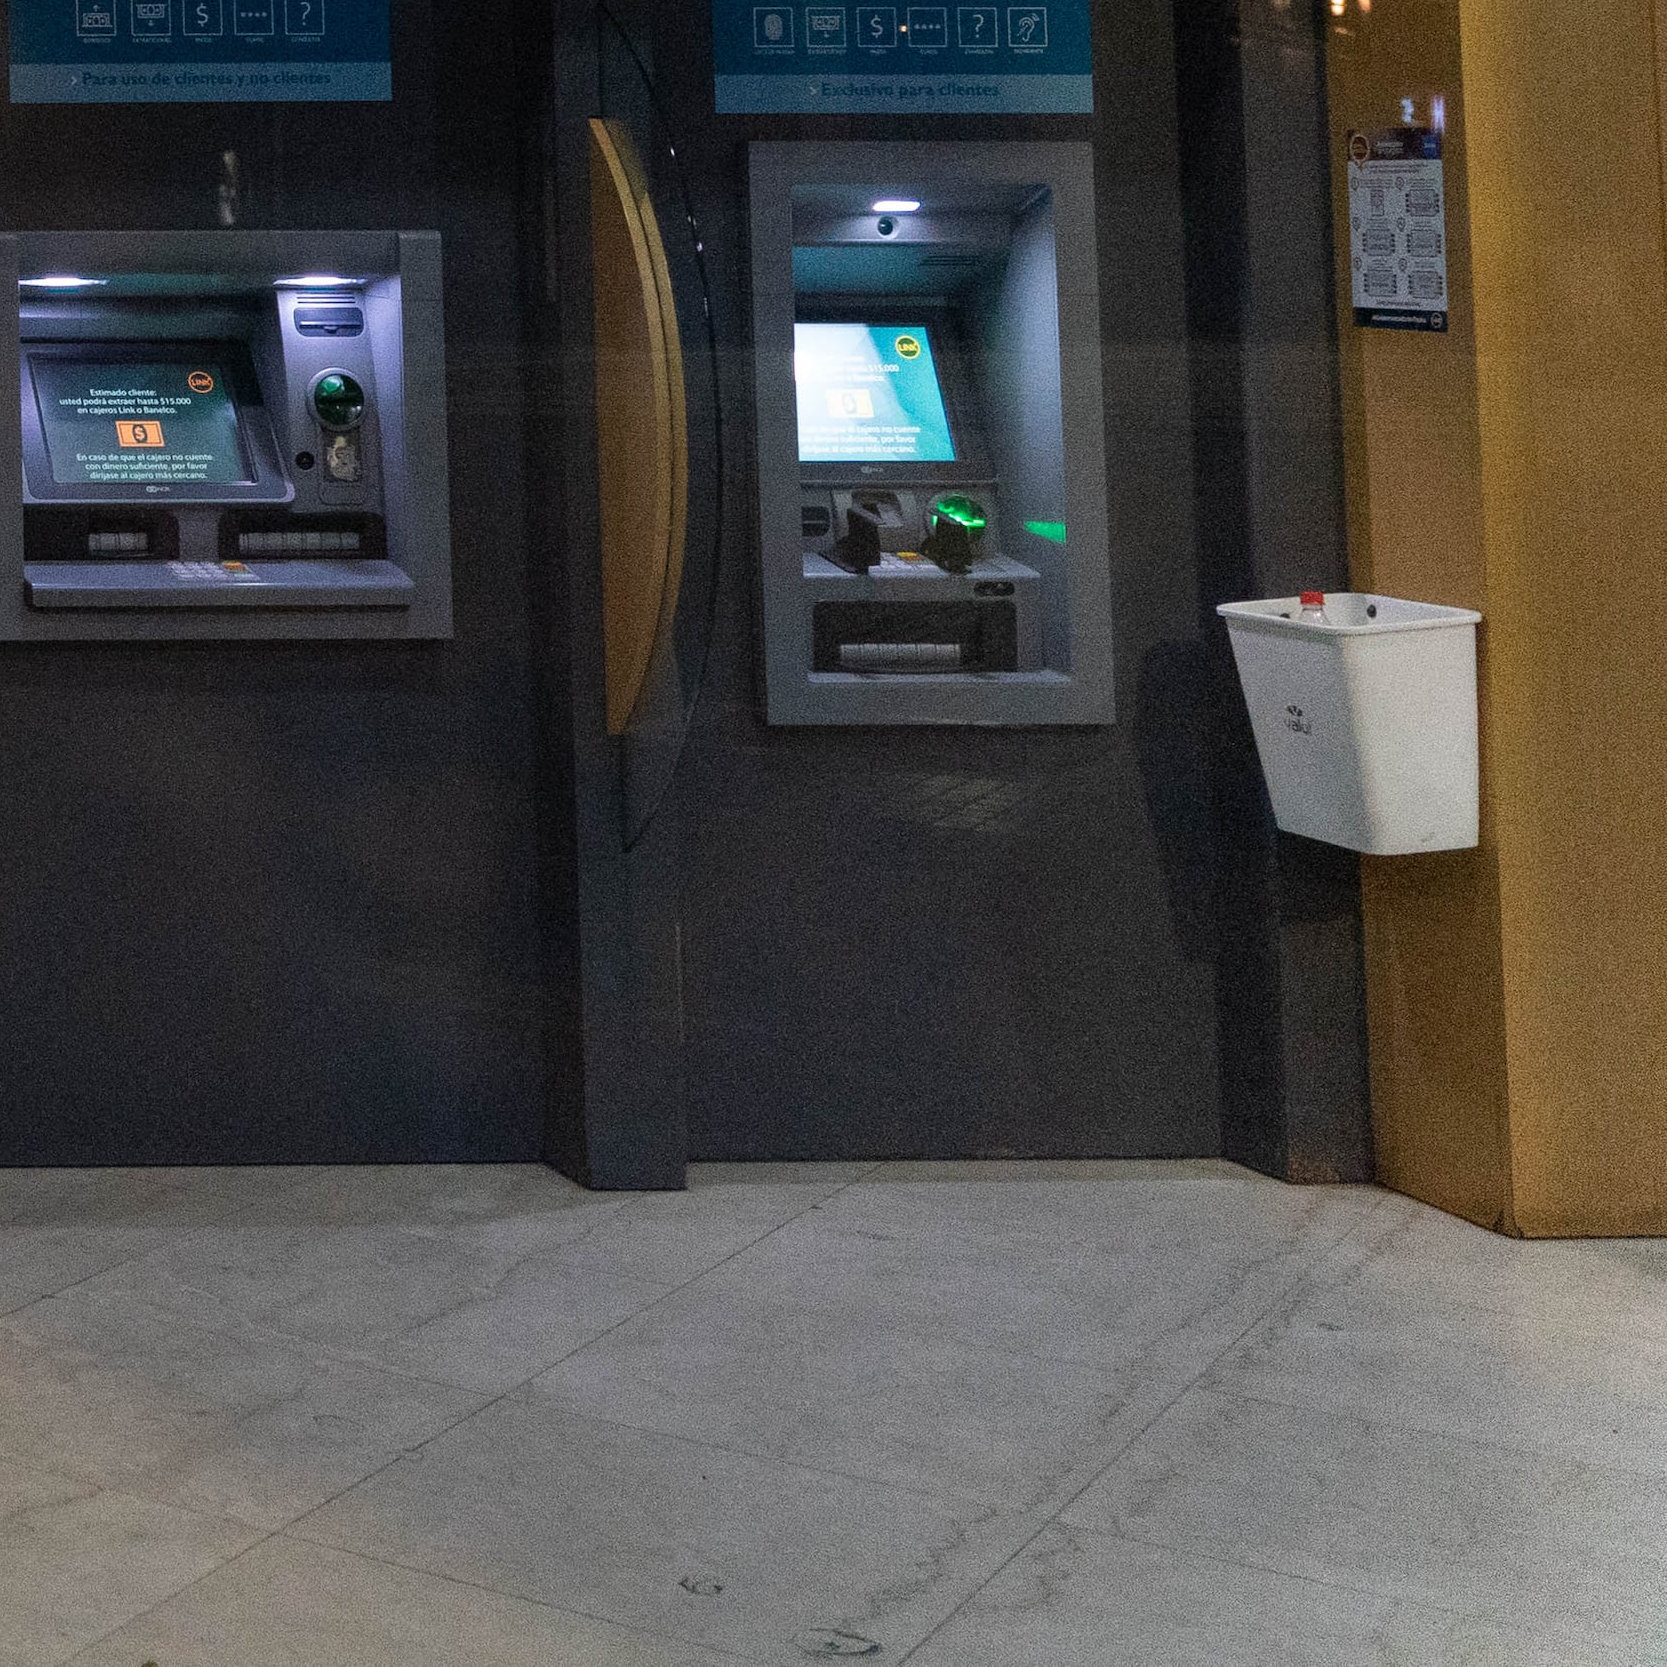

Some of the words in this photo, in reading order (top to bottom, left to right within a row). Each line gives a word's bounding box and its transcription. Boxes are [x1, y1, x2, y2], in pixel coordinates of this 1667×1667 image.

[82, 72, 117, 85] Para
[121, 75, 148, 85] uso
[152, 71, 171, 85] de
[175, 71, 233, 85] clientes
[236, 74, 245, 88] y
[250, 74, 269, 85] no
[274, 71, 332, 85] clientes
[821, 82, 894, 96] Exclusivo
[899, 86, 935, 99] para
[940, 82, 1000, 96] clientes
[898, 343, 918, 352] LINK
[90, 388, 127, 396] Estimado
[59, 397, 82, 405] usted
[83, 397, 107, 407] podrá
[137, 397, 159, 405] hasta
[160, 397, 192, 406] $15.000
[89, 406, 118, 416] cajeros
[119, 406, 136, 414] Link
[120, 455, 136, 463] que
[146, 454, 171, 463] cajero
[101, 462, 128, 470] dinero
[171, 464, 186, 472] por
[186, 462, 208, 470] favor
[120, 471, 129, 479] al
[129, 472, 154, 481] cajero
